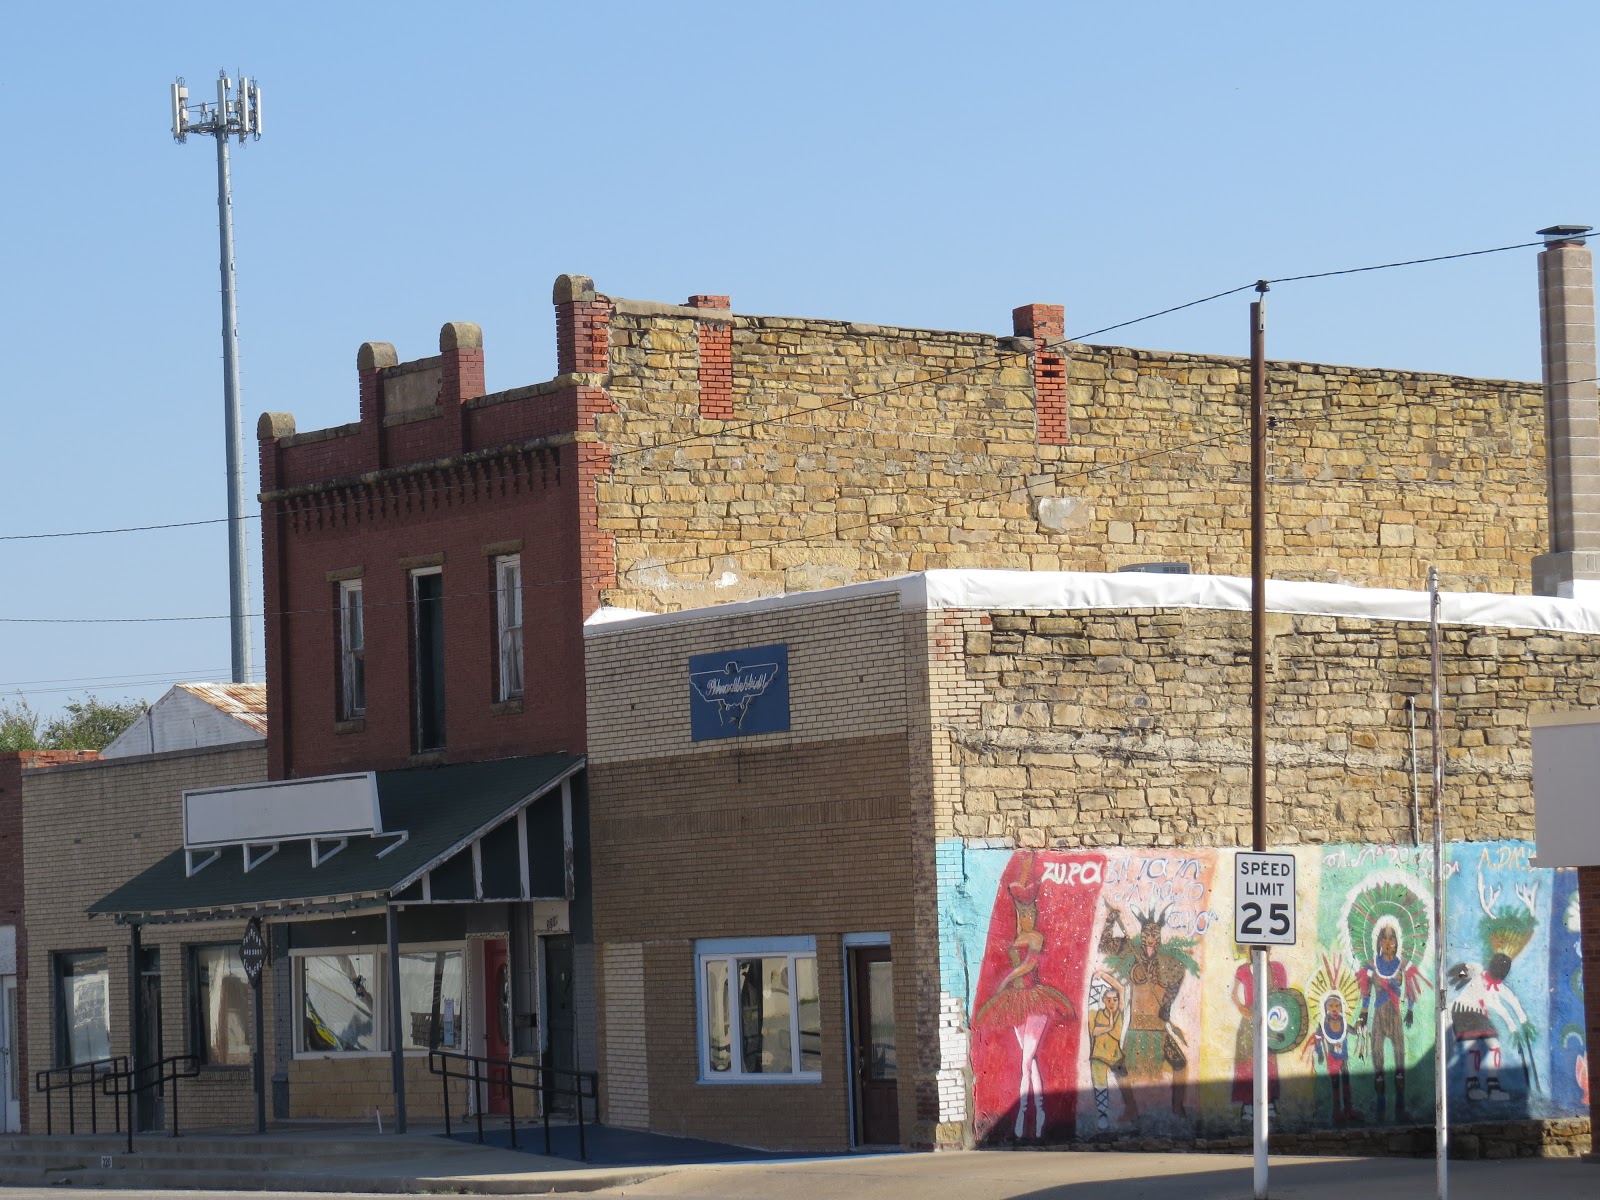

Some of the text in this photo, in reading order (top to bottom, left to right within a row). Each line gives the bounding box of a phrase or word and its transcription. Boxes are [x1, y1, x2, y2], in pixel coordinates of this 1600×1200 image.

[1240, 861, 1291, 877] SPEED
[1245, 881, 1285, 897] LIMIT
[1240, 901, 1291, 936] 25
[243, 958, 263, 977] FLOWERS
